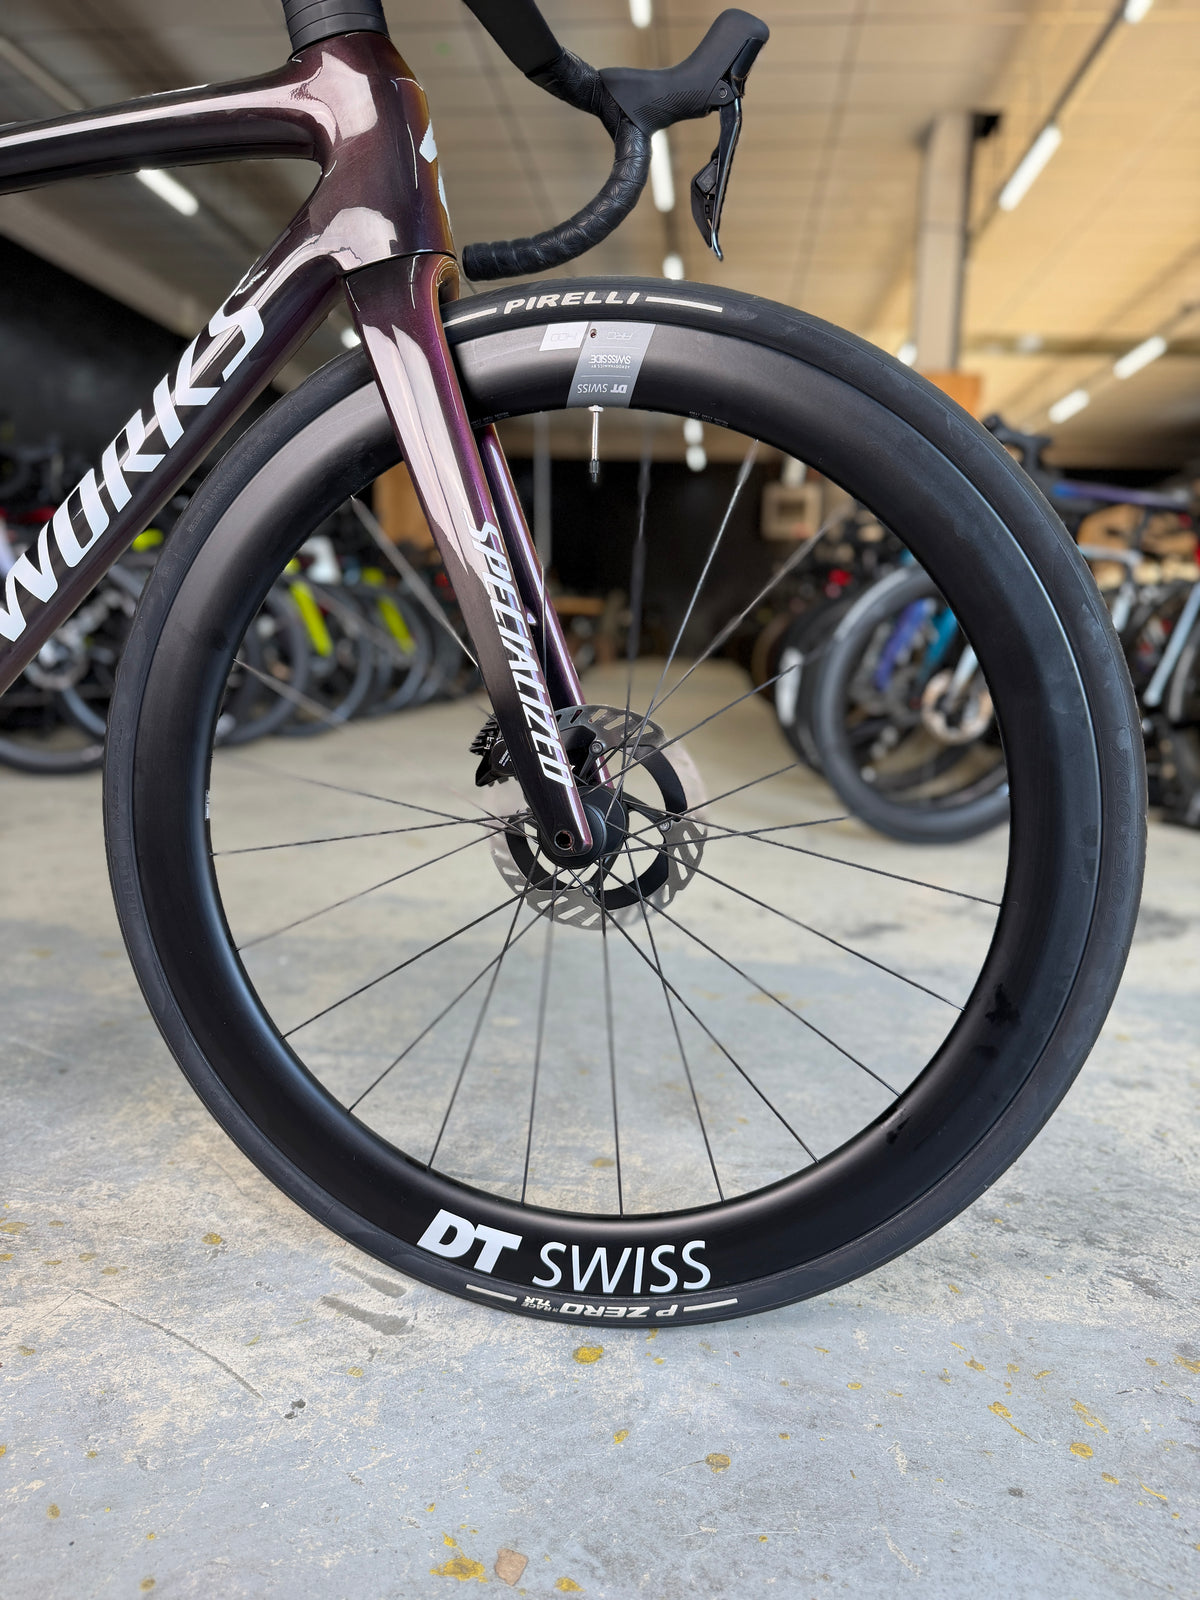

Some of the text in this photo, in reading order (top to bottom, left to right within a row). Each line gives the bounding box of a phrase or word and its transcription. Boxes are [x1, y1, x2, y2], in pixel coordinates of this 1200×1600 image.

[503, 291, 640, 315] PIRELLI
[577, 383, 628, 394] DT SWISS
[0, 256, 265, 643] WORKS
[463, 509, 574, 788] SPECIALIZED
[416, 1208, 712, 1295] DT SWISS
[524, 1295, 551, 1307] TLR
[559, 1302, 650, 1318] ZERO
[655, 1304, 679, 1317] P
